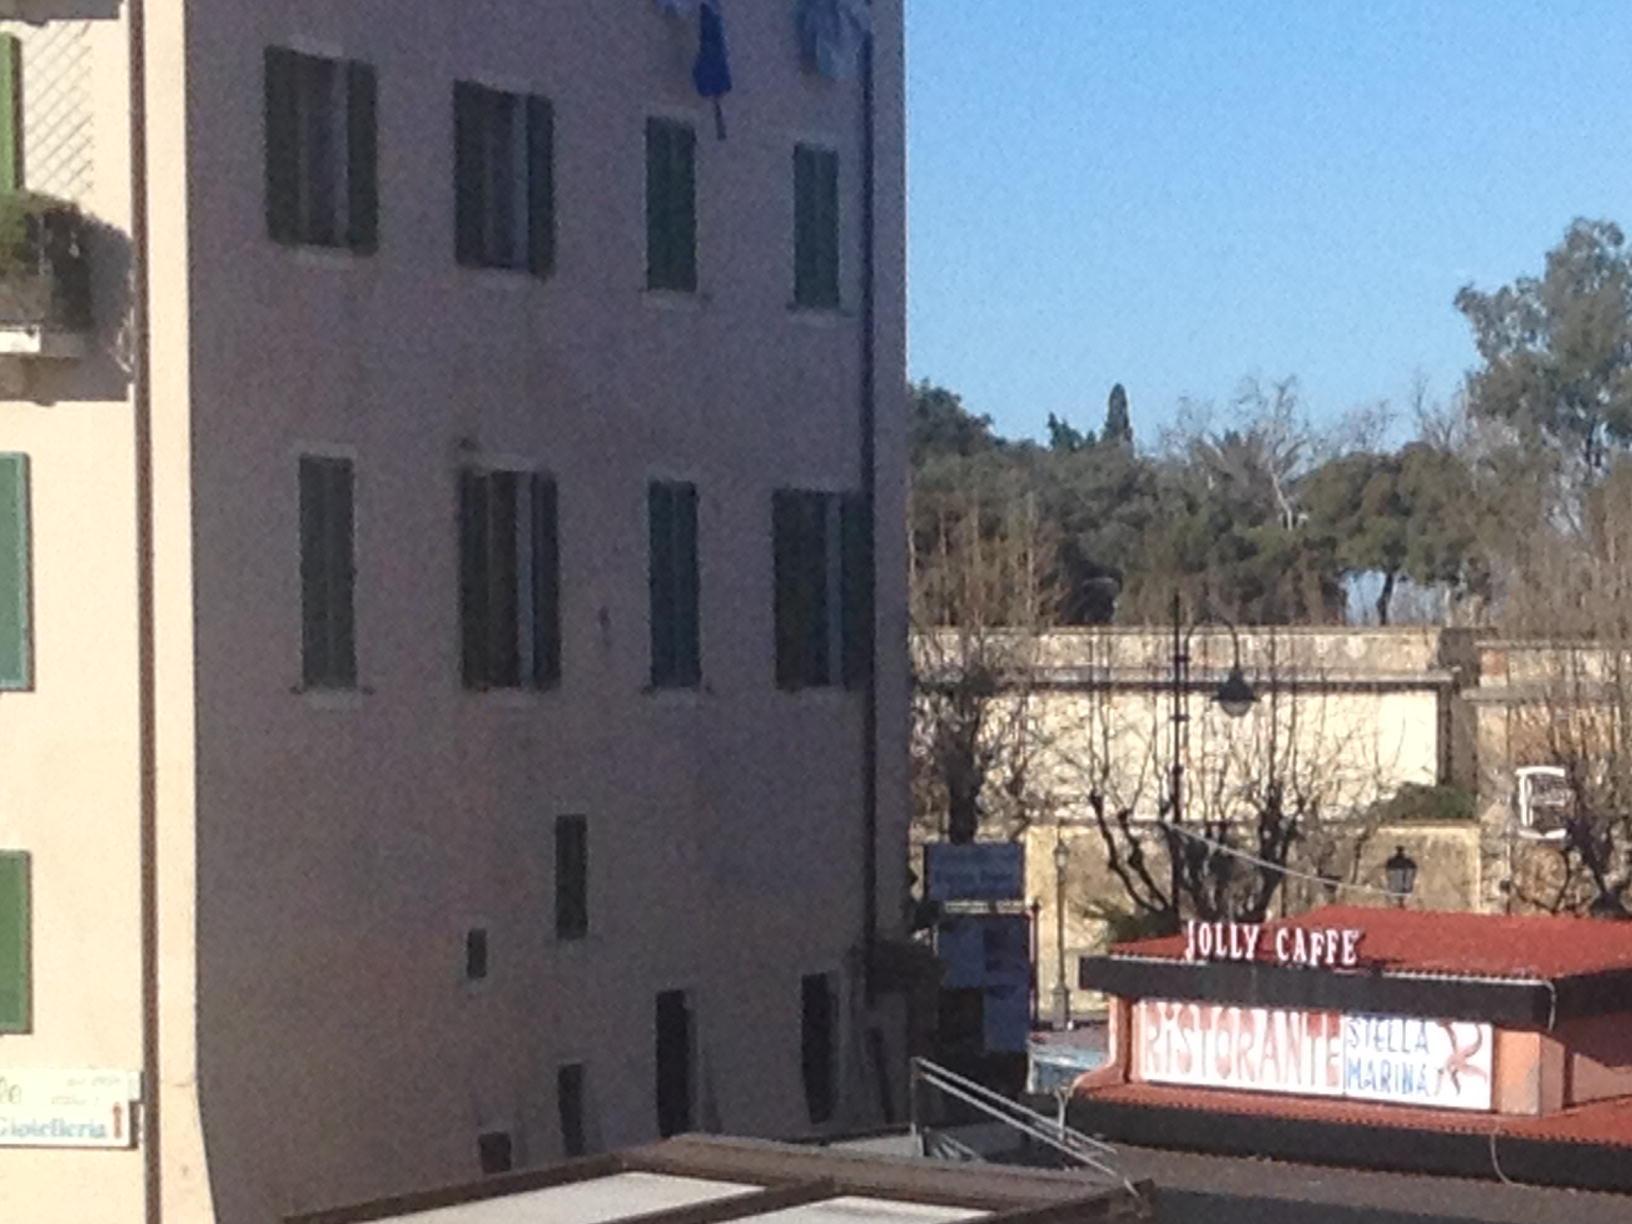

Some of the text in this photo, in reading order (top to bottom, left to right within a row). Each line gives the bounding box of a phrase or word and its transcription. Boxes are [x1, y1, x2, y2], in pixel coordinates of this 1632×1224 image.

[1184, 919, 1260, 962] JOLLY
[1143, 1000, 1341, 1087] RISTORANTE
[1348, 1016, 1430, 1054] STELLA
[1347, 1056, 1431, 1097] MARINA
